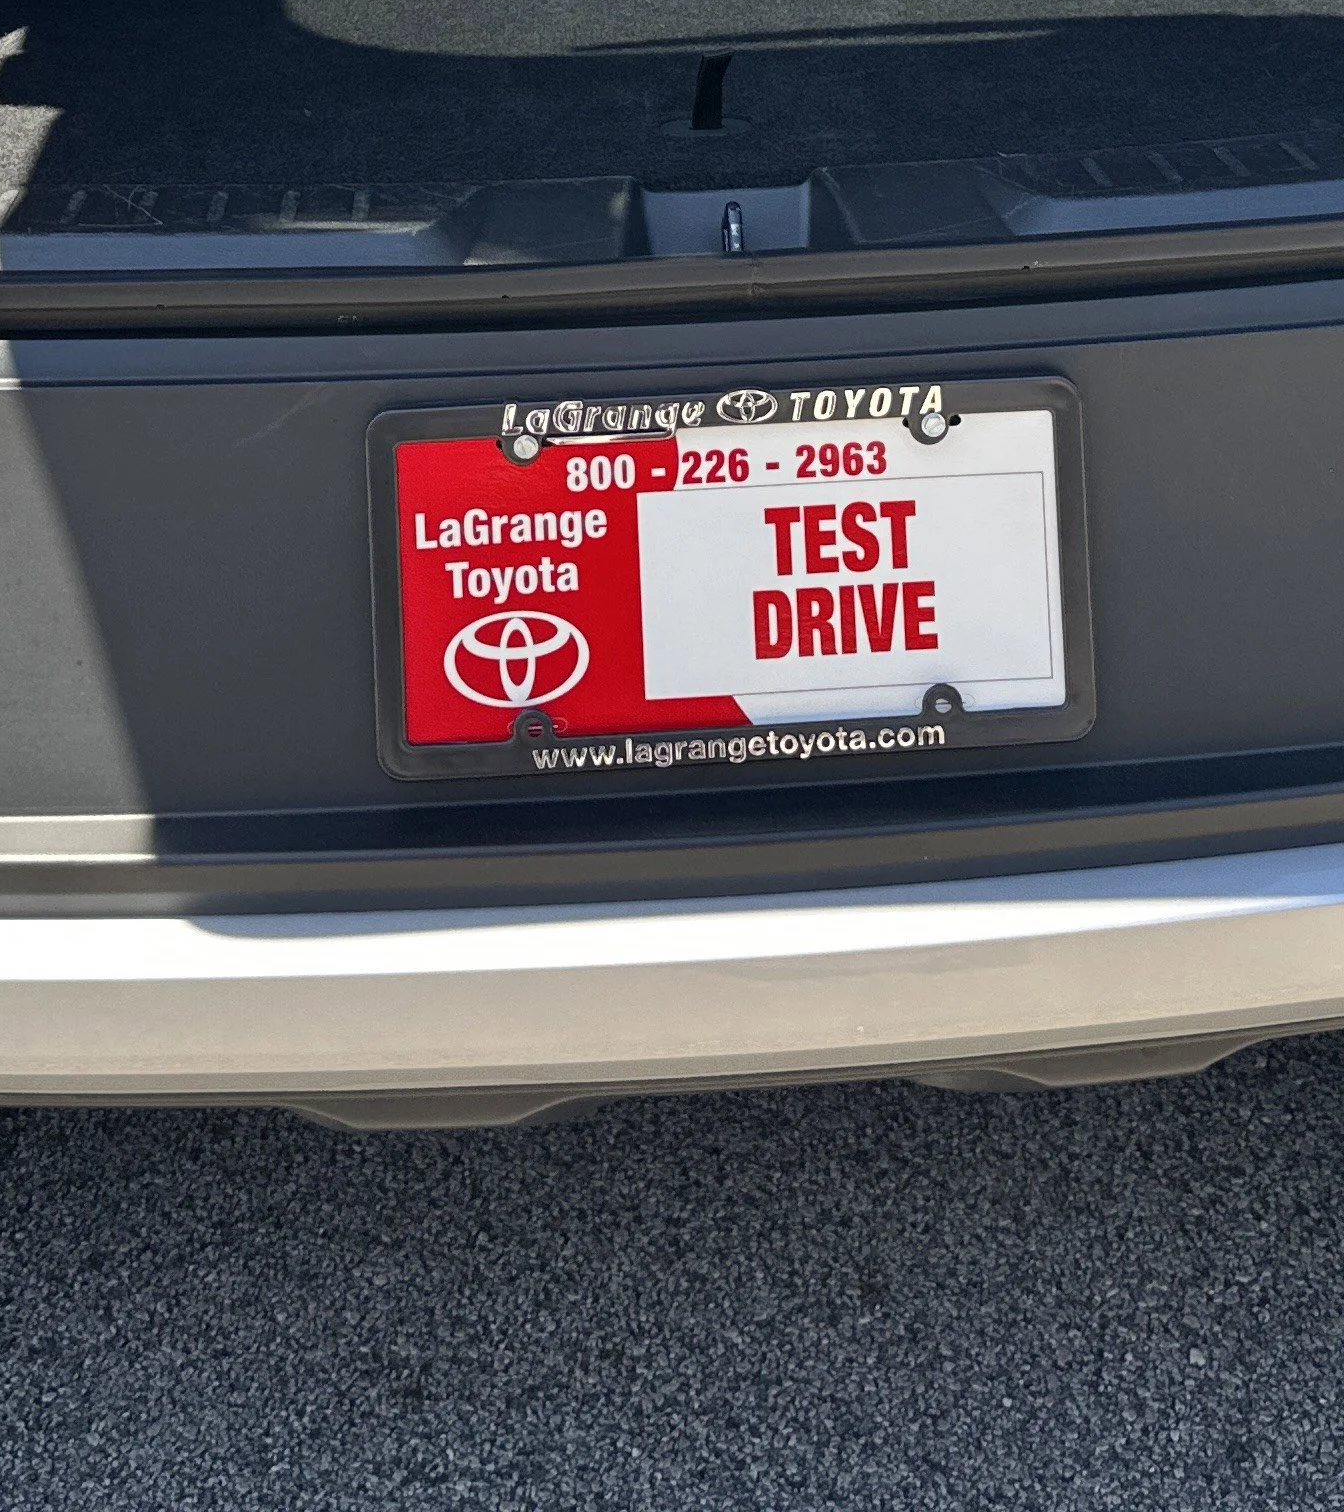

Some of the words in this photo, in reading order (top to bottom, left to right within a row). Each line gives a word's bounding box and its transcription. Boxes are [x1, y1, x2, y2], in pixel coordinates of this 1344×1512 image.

[500, 398, 707, 442] LaGrange
[789, 384, 943, 422] TOYOTA
[565, 453, 637, 493] 800
[681, 447, 749, 485] 226
[795, 441, 887, 478] 2963
[414, 507, 608, 550] LaGrange
[763, 499, 917, 577] TEST
[444, 556, 580, 605] Toyota
[752, 580, 939, 660] DRIVE
[532, 722, 946, 769] www.lagrangetoyota.com
